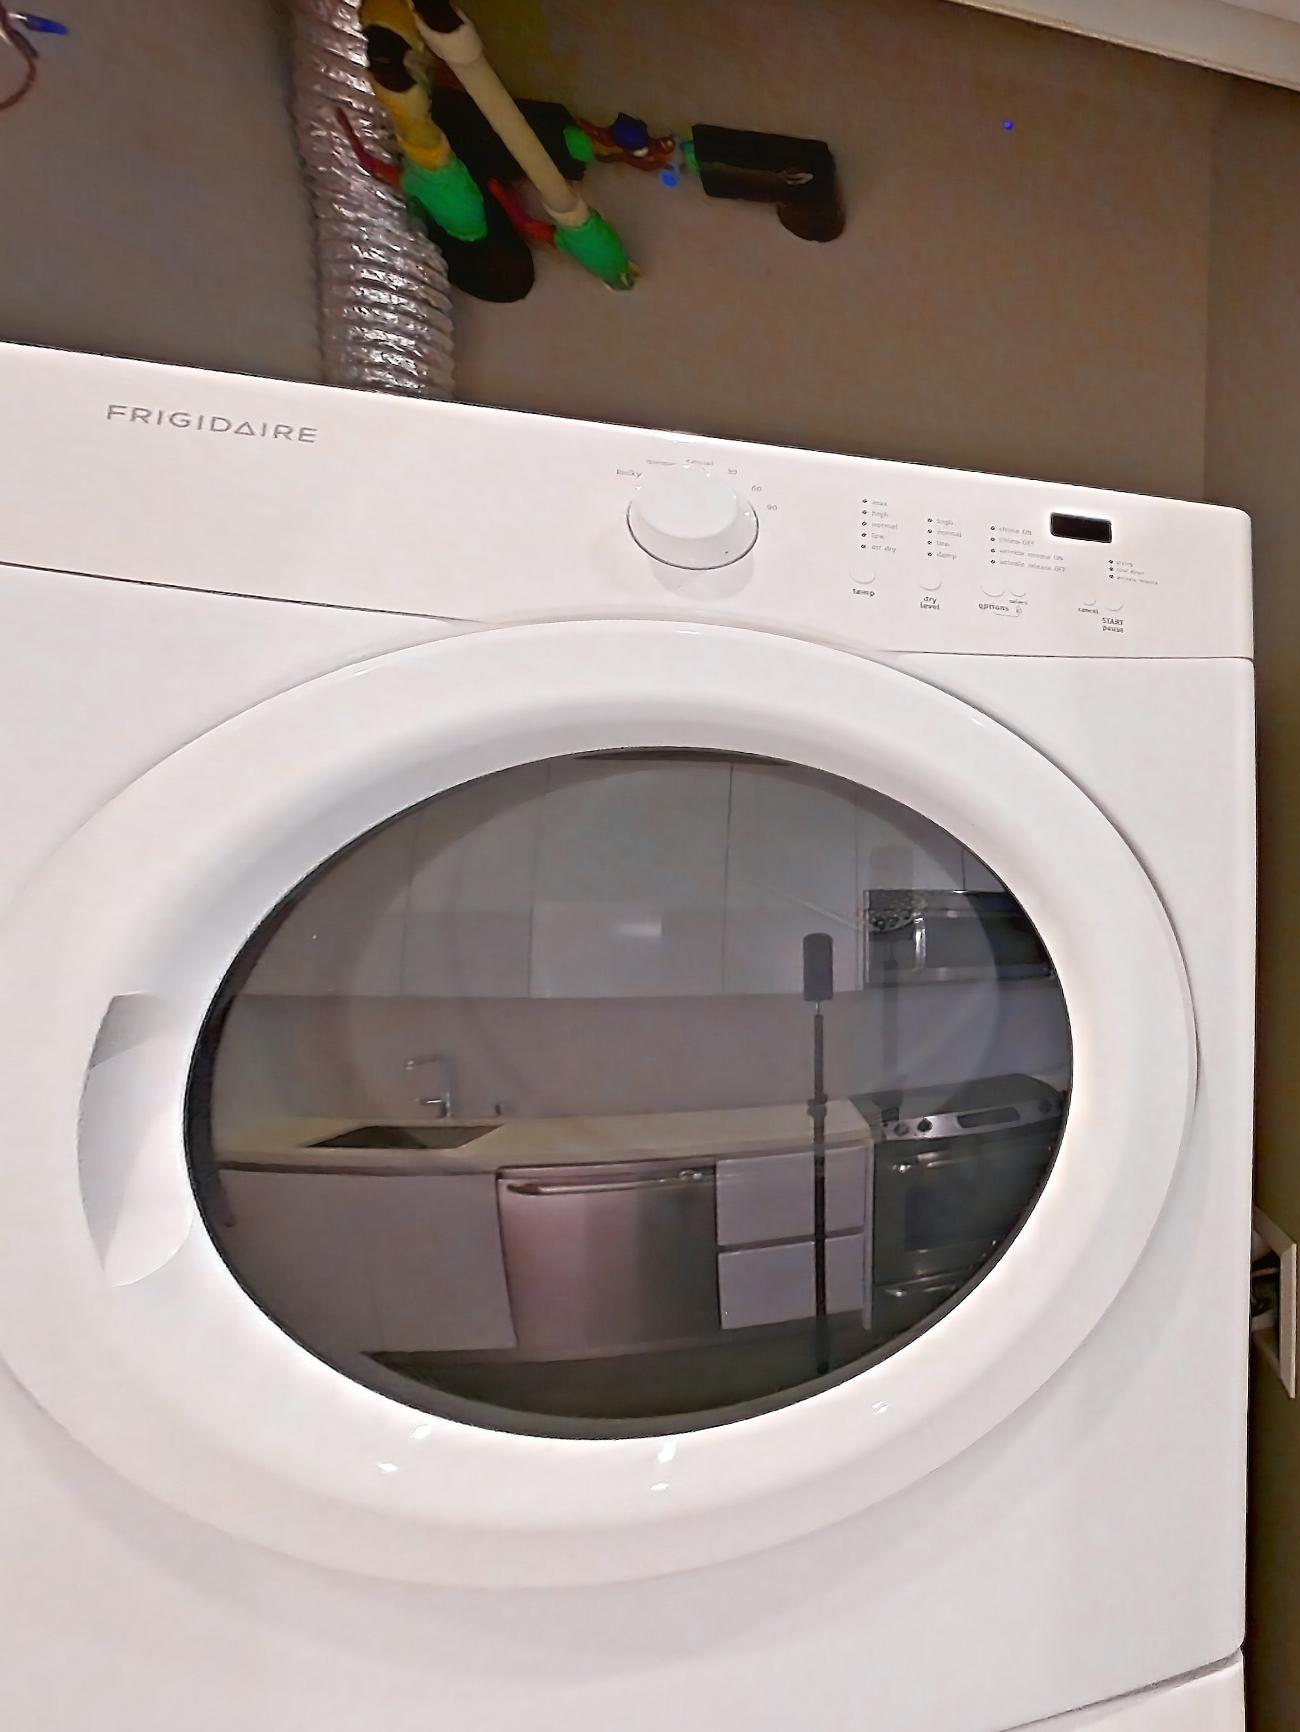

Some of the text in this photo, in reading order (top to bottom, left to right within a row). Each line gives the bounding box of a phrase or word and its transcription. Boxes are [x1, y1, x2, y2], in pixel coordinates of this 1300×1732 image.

[106, 404, 318, 443] FRIGIDAIRE
[852, 588, 875, 597] temp
[923, 596, 937, 604] dry
[920, 602, 940, 610] level
[978, 602, 1009, 612] options
[1102, 617, 1124, 626] START
